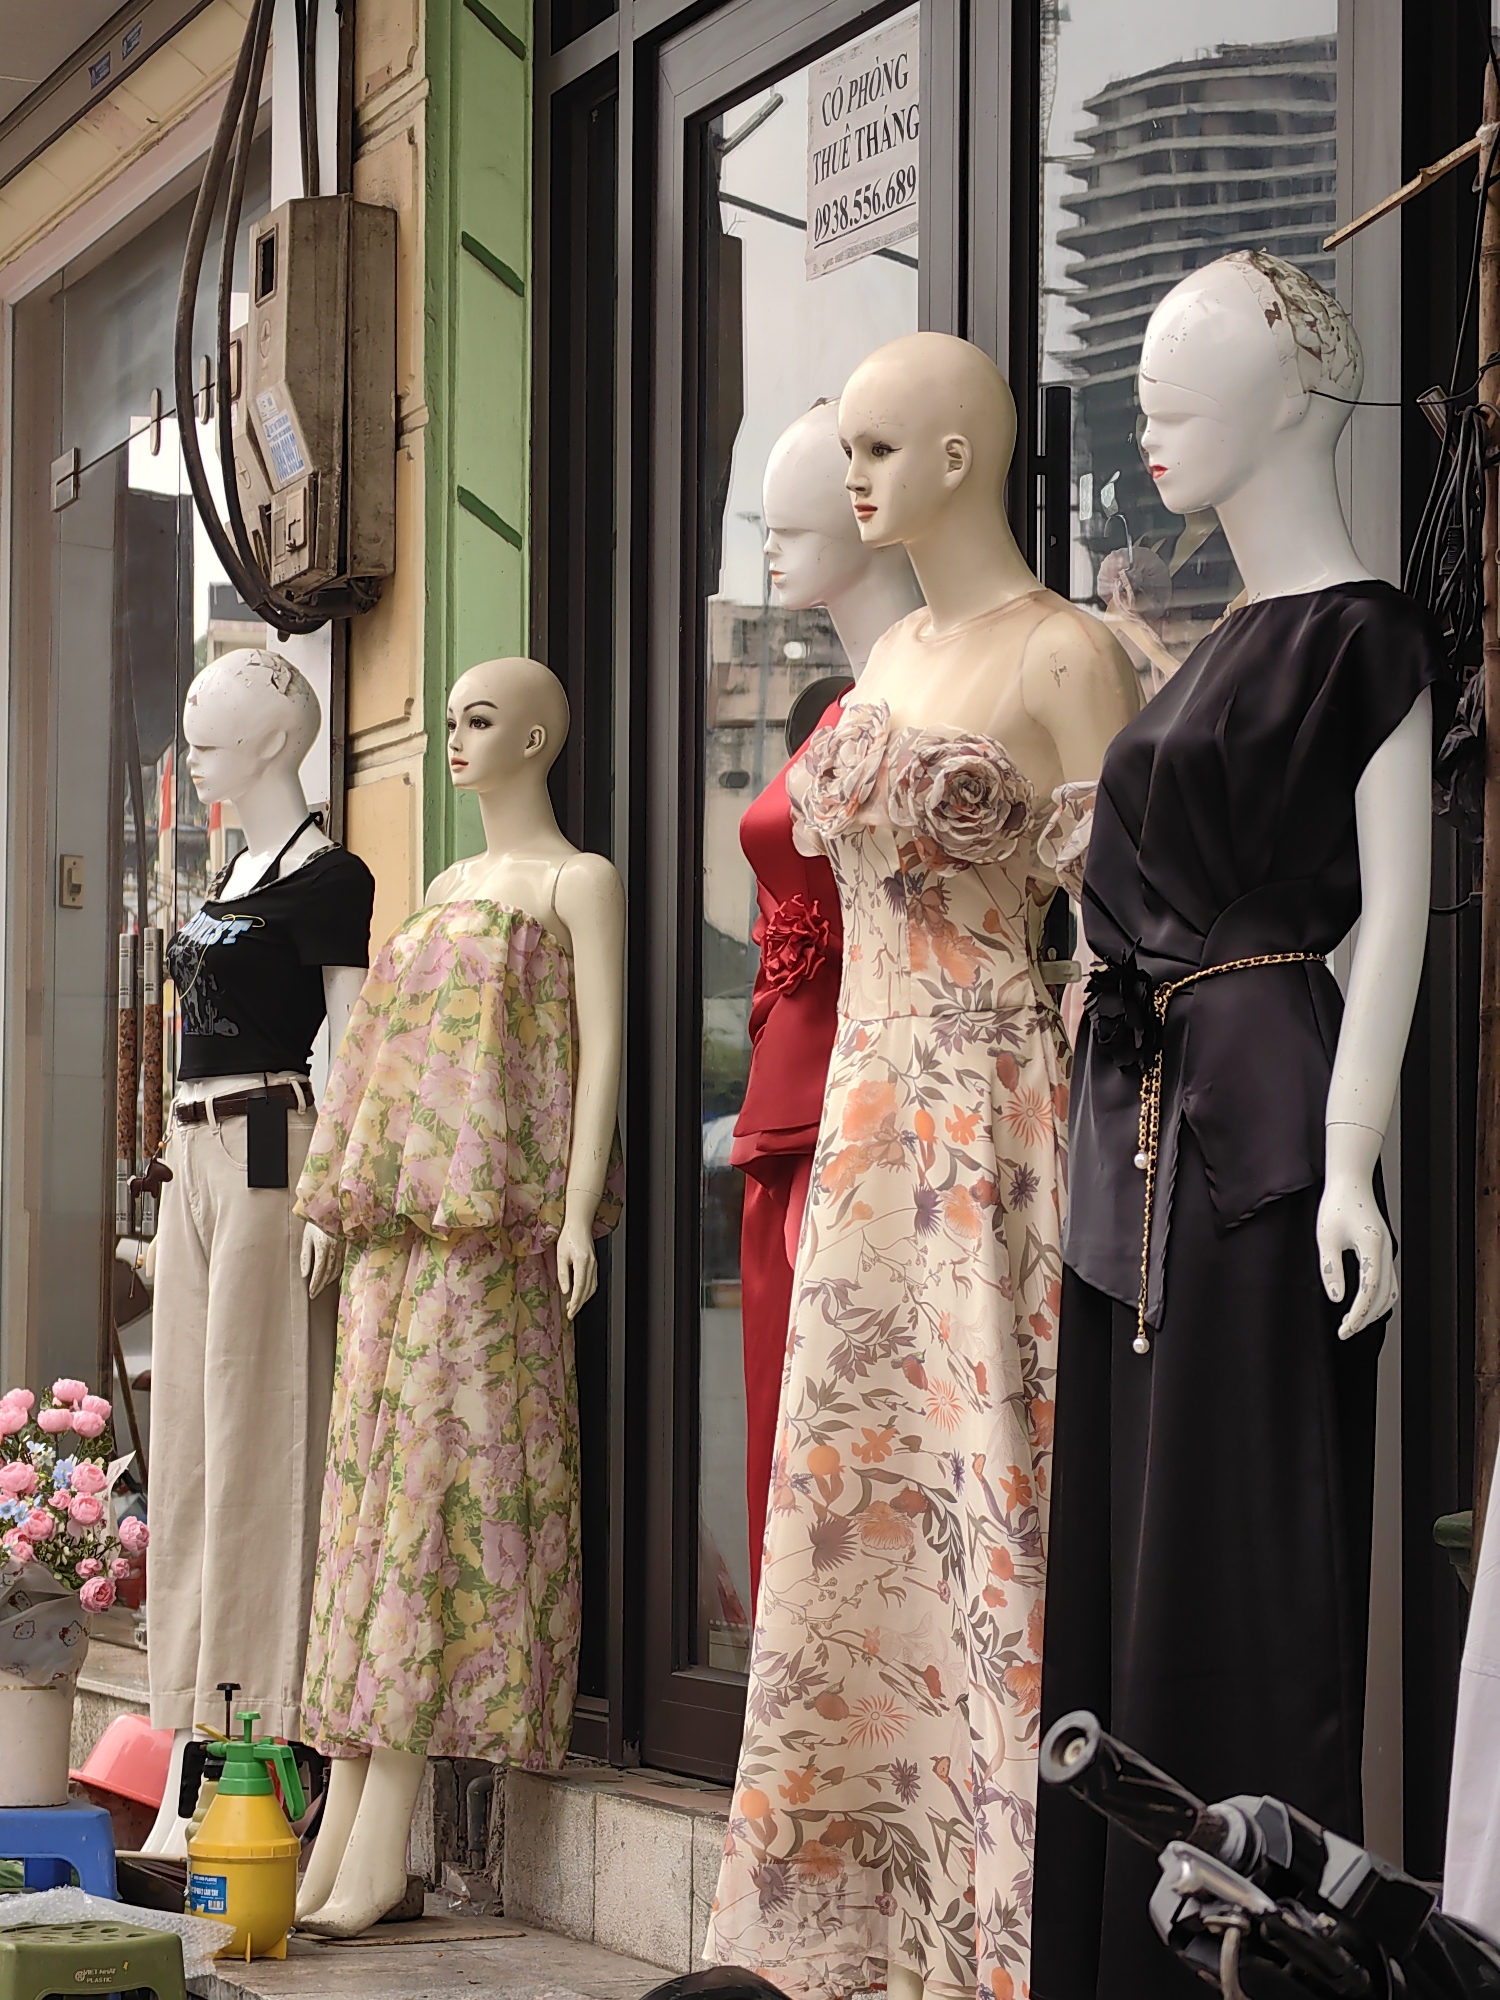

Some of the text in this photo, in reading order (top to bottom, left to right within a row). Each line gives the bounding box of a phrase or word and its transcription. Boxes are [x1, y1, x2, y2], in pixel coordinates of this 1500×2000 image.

[821, 52, 908, 127] CÓ PHÒNG
[813, 104, 920, 186] THUÊ THÁNG
[814, 164, 917, 242] 0938.556.689
